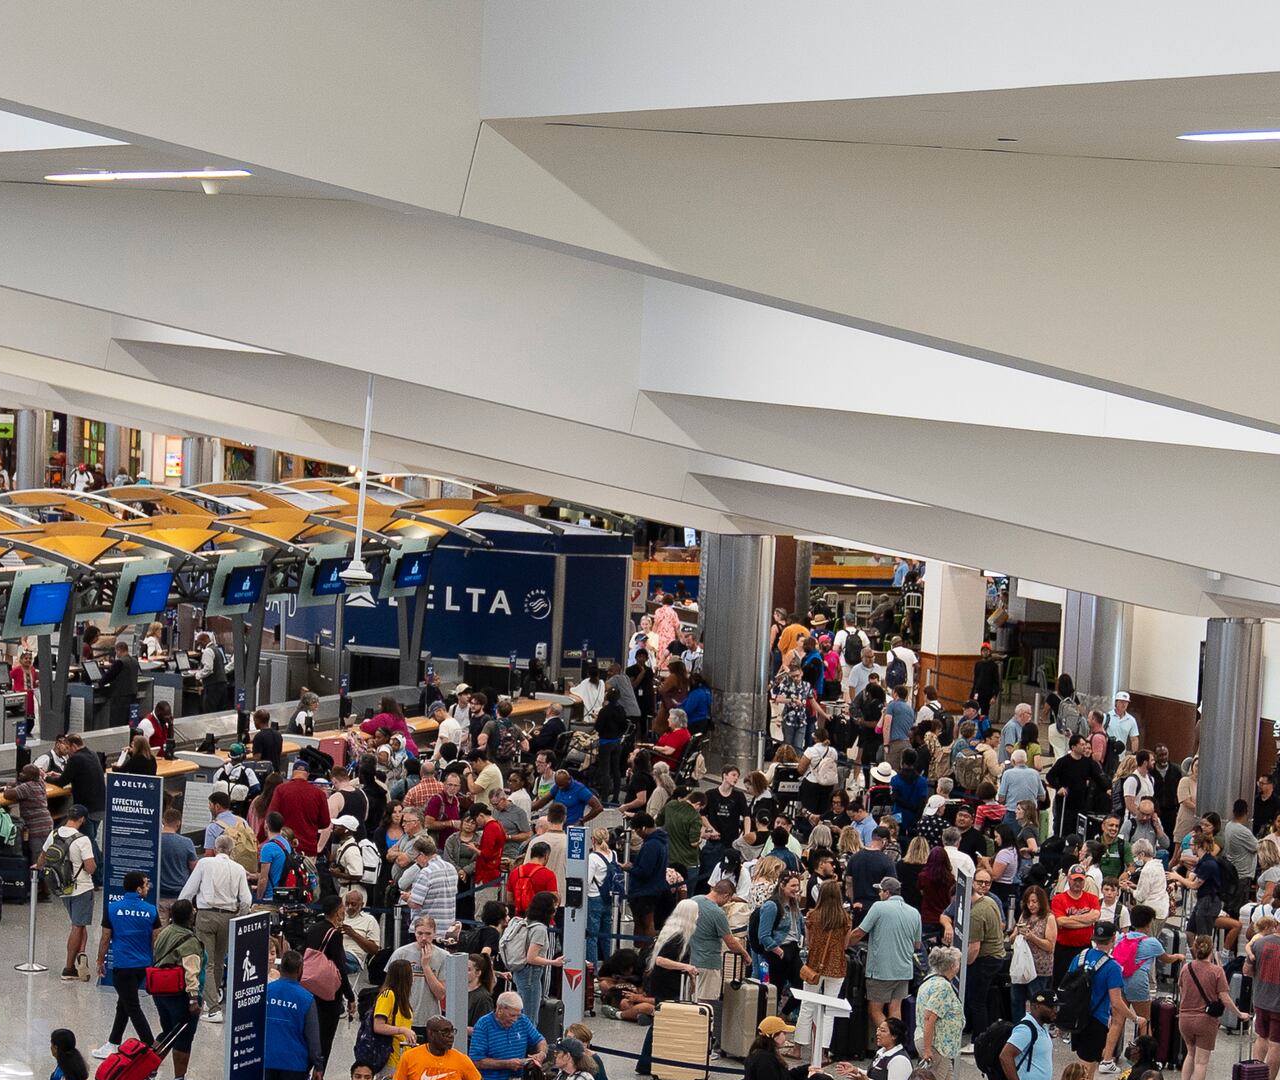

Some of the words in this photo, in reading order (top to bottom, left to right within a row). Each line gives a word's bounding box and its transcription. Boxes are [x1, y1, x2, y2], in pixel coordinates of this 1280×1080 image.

[121, 781, 147, 789] DELTA
[111, 798, 143, 807] EFFECTIVE
[111, 805, 155, 815] IMMEDIATELY
[124, 909, 150, 918] DELTA
[243, 921, 262, 934] DELTA
[234, 983, 265, 1000] SELF-SERVICE
[237, 997, 247, 1009] BAG
[247, 994, 261, 1008] DROP
[271, 998, 298, 1010] DELTA
